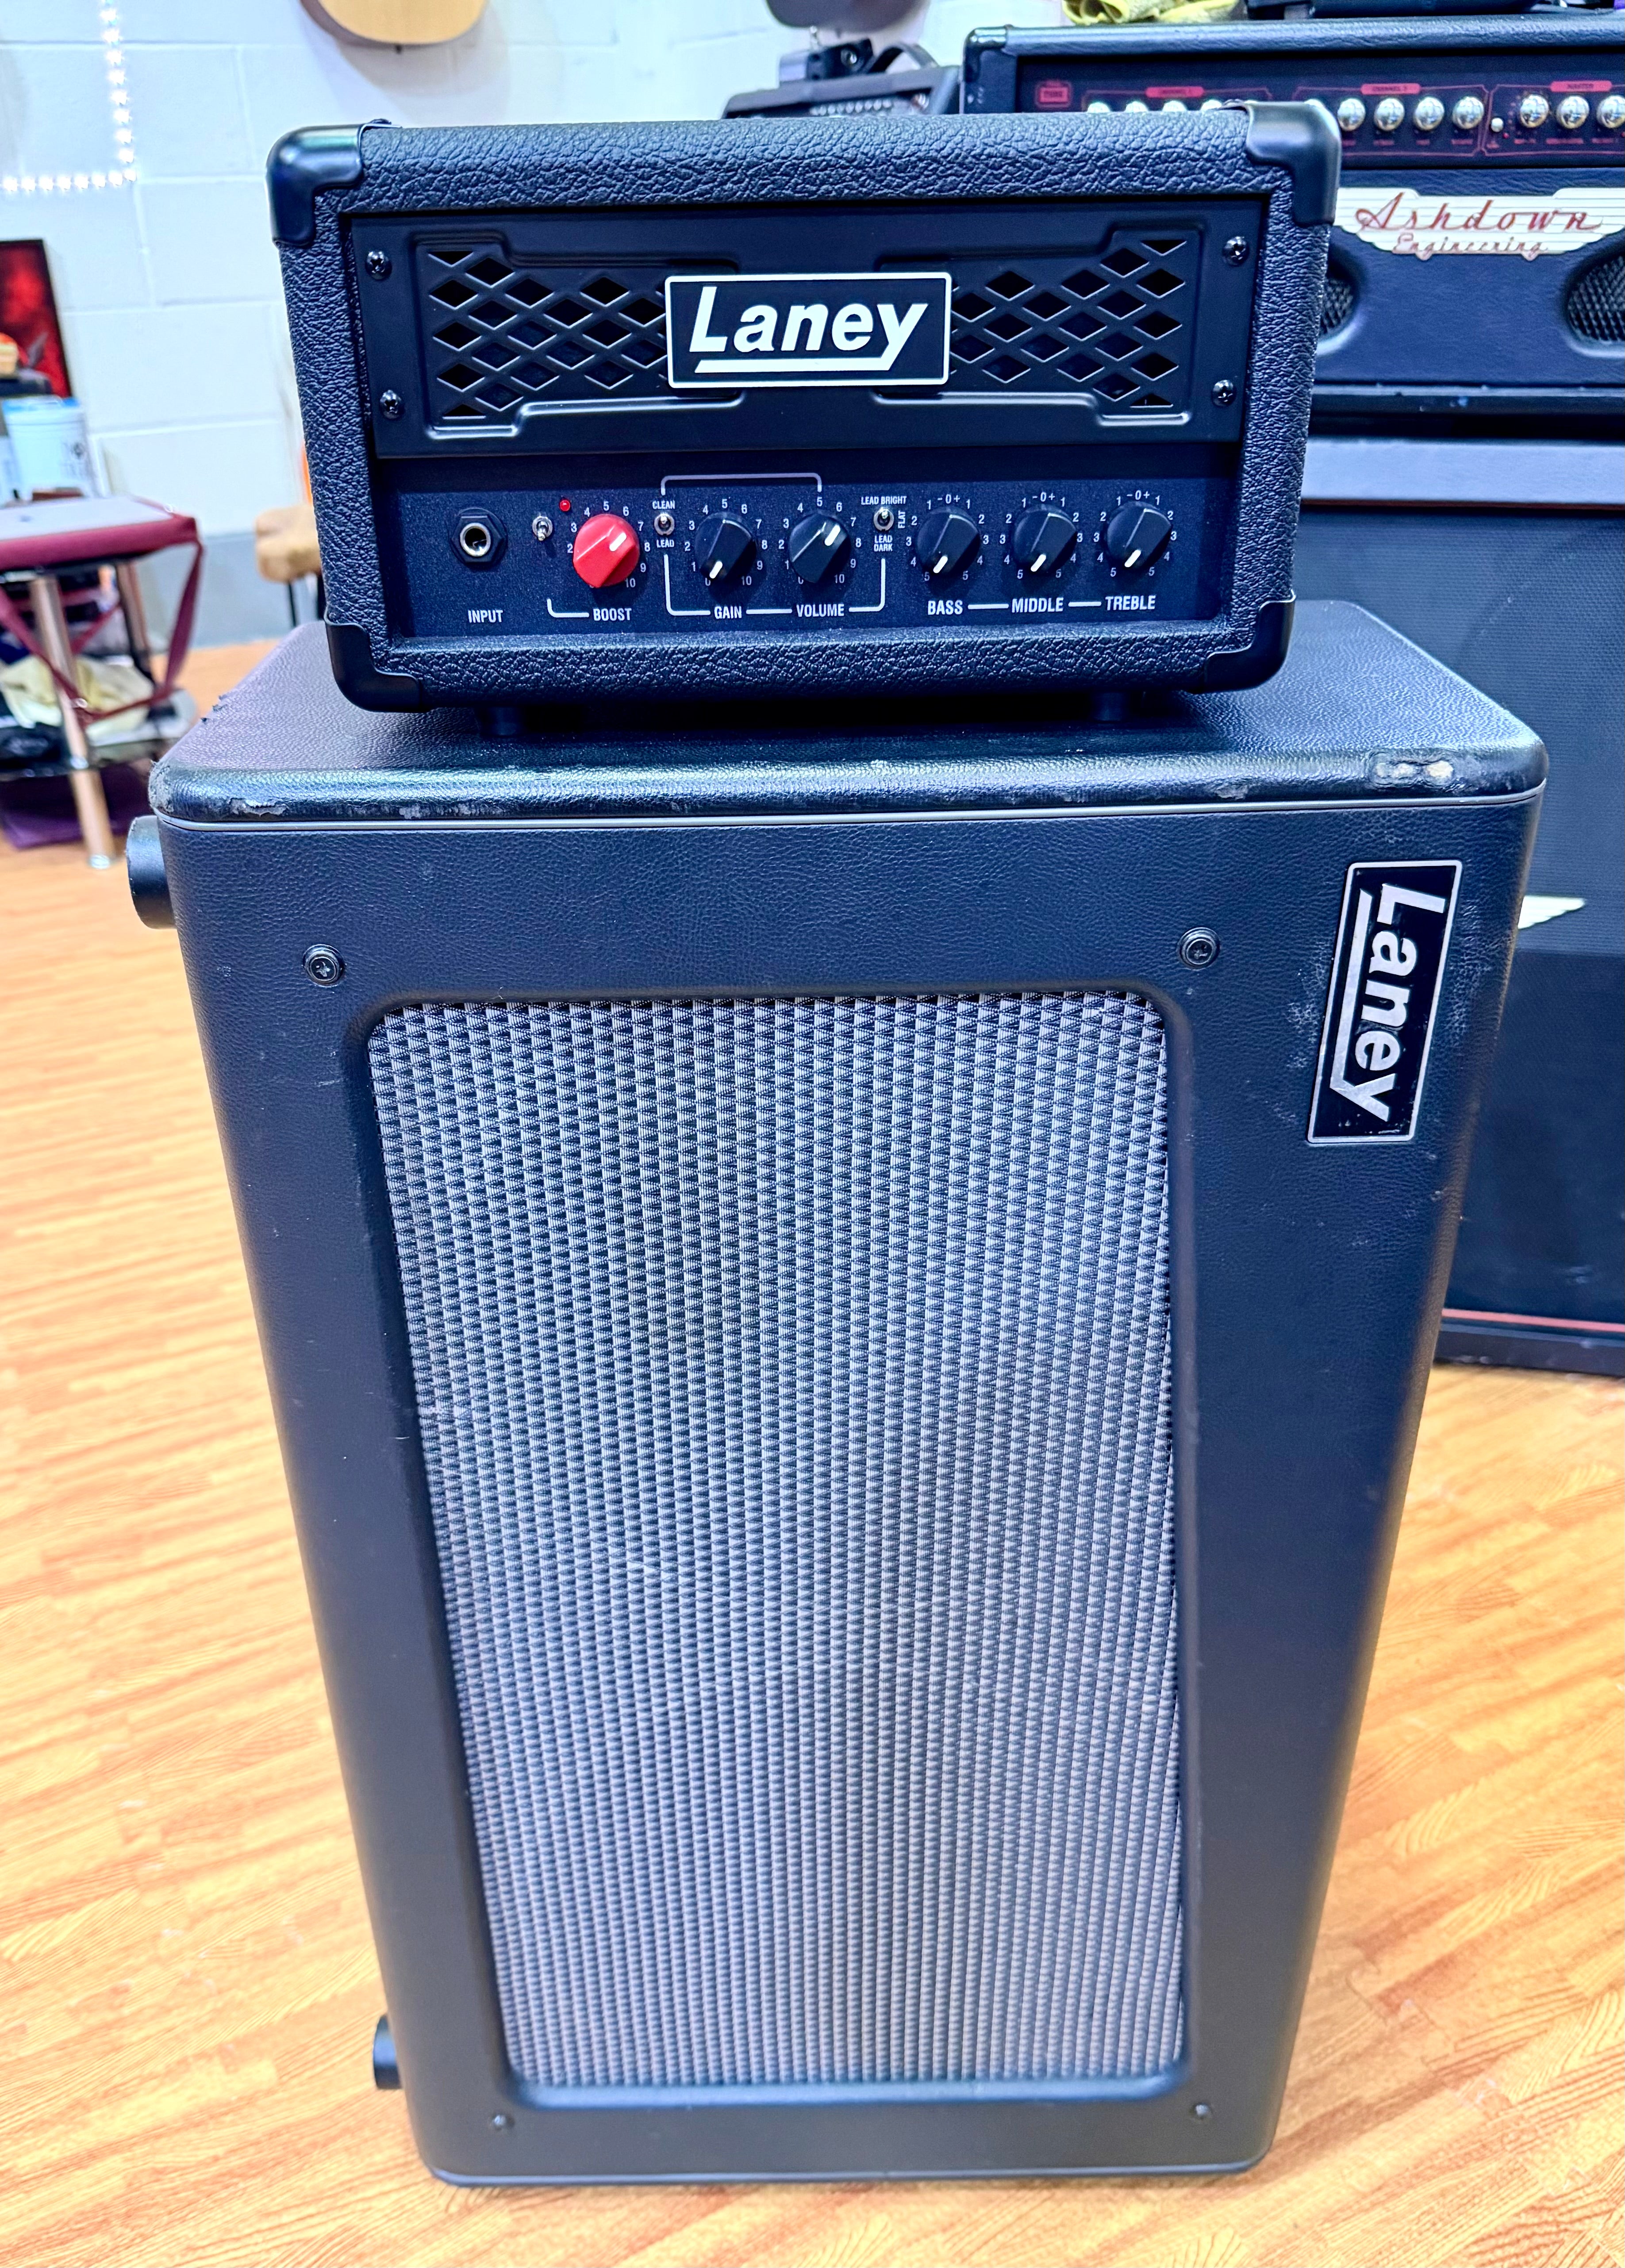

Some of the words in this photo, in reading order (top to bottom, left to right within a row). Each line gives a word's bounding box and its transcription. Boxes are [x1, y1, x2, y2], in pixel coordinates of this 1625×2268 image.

[1356, 192, 1603, 230] Ashdown
[1392, 233, 1548, 261] Engineering
[690, 286, 928, 373] Laney
[652, 500, 675, 510] CLEAN
[722, 499, 728, 509] 5
[817, 496, 823, 507] 5
[861, 496, 879, 505] LEAD
[880, 495, 907, 505] BRIGHT
[927, 499, 931, 510] 1
[966, 499, 970, 509] 1
[1022, 498, 1026, 508] 1
[1060, 497, 1065, 507] 1
[1116, 496, 1121, 506] 1
[1155, 495, 1160, 505] 1
[603, 501, 609, 511] 5
[622, 506, 629, 516] 6
[702, 505, 708, 515] 4
[741, 504, 748, 514] 6
[797, 503, 803, 513] 4
[836, 502, 842, 512] 6
[584, 507, 590, 517] 4
[1072, 512, 1079, 522] 2
[1100, 511, 1106, 522] 2
[1167, 510, 1174, 520] 2
[756, 519, 762, 529] 7
[783, 518, 789, 529] 3
[850, 517, 857, 527] 7
[911, 515, 918, 526] 2
[978, 514, 985, 524] 2
[1005, 514, 1012, 524] 2
[571, 522, 577, 533] 3
[638, 521, 644, 531] 7
[689, 520, 695, 530] 3
[874, 535, 893, 544] LEAD
[906, 536, 912, 546] 3
[983, 534, 989, 545] 3
[999, 534, 1006, 544] 3
[1076, 533, 1083, 542] 3
[1093, 532, 1100, 542] 3
[1170, 531, 1177, 541] 3
[644, 542, 650, 552] 8
[656, 538, 675, 548] LEAD
[684, 541, 691, 552] 2
[761, 539, 768, 550] 8
[778, 539, 784, 549] 2
[855, 537, 862, 548] 8
[873, 543, 893, 552] DARK
[567, 543, 573, 553] 2
[977, 555, 983, 565] 4
[1004, 555, 1010, 564] 4
[1070, 553, 1076, 563] 4
[1097, 552, 1103, 563] 4
[1164, 551, 1170, 561] 4
[691, 561, 695, 572] 1
[757, 560, 763, 570] 9
[785, 560, 789, 570] 1
[850, 558, 856, 568] 9
[910, 556, 916, 567] 4
[640, 563, 646, 572] 9
[1110, 567, 1116, 577] 5
[1148, 567, 1155, 576] 5
[835, 574, 845, 583] 10
[962, 570, 968, 580] 5
[1017, 569, 1023, 579] 5
[626, 578, 636, 588] 10
[742, 576, 752, 586] 10
[927, 600, 963, 615] BASS
[1011, 597, 1064, 613] MIDDLE
[1105, 595, 1156, 610] TREBLE
[593, 608, 632, 621] BOOST
[714, 606, 742, 619] GAIN
[796, 603, 845, 617] VOLUME
[468, 610, 503, 623] INPUT
[1329, 883, 1445, 1121] Laney
